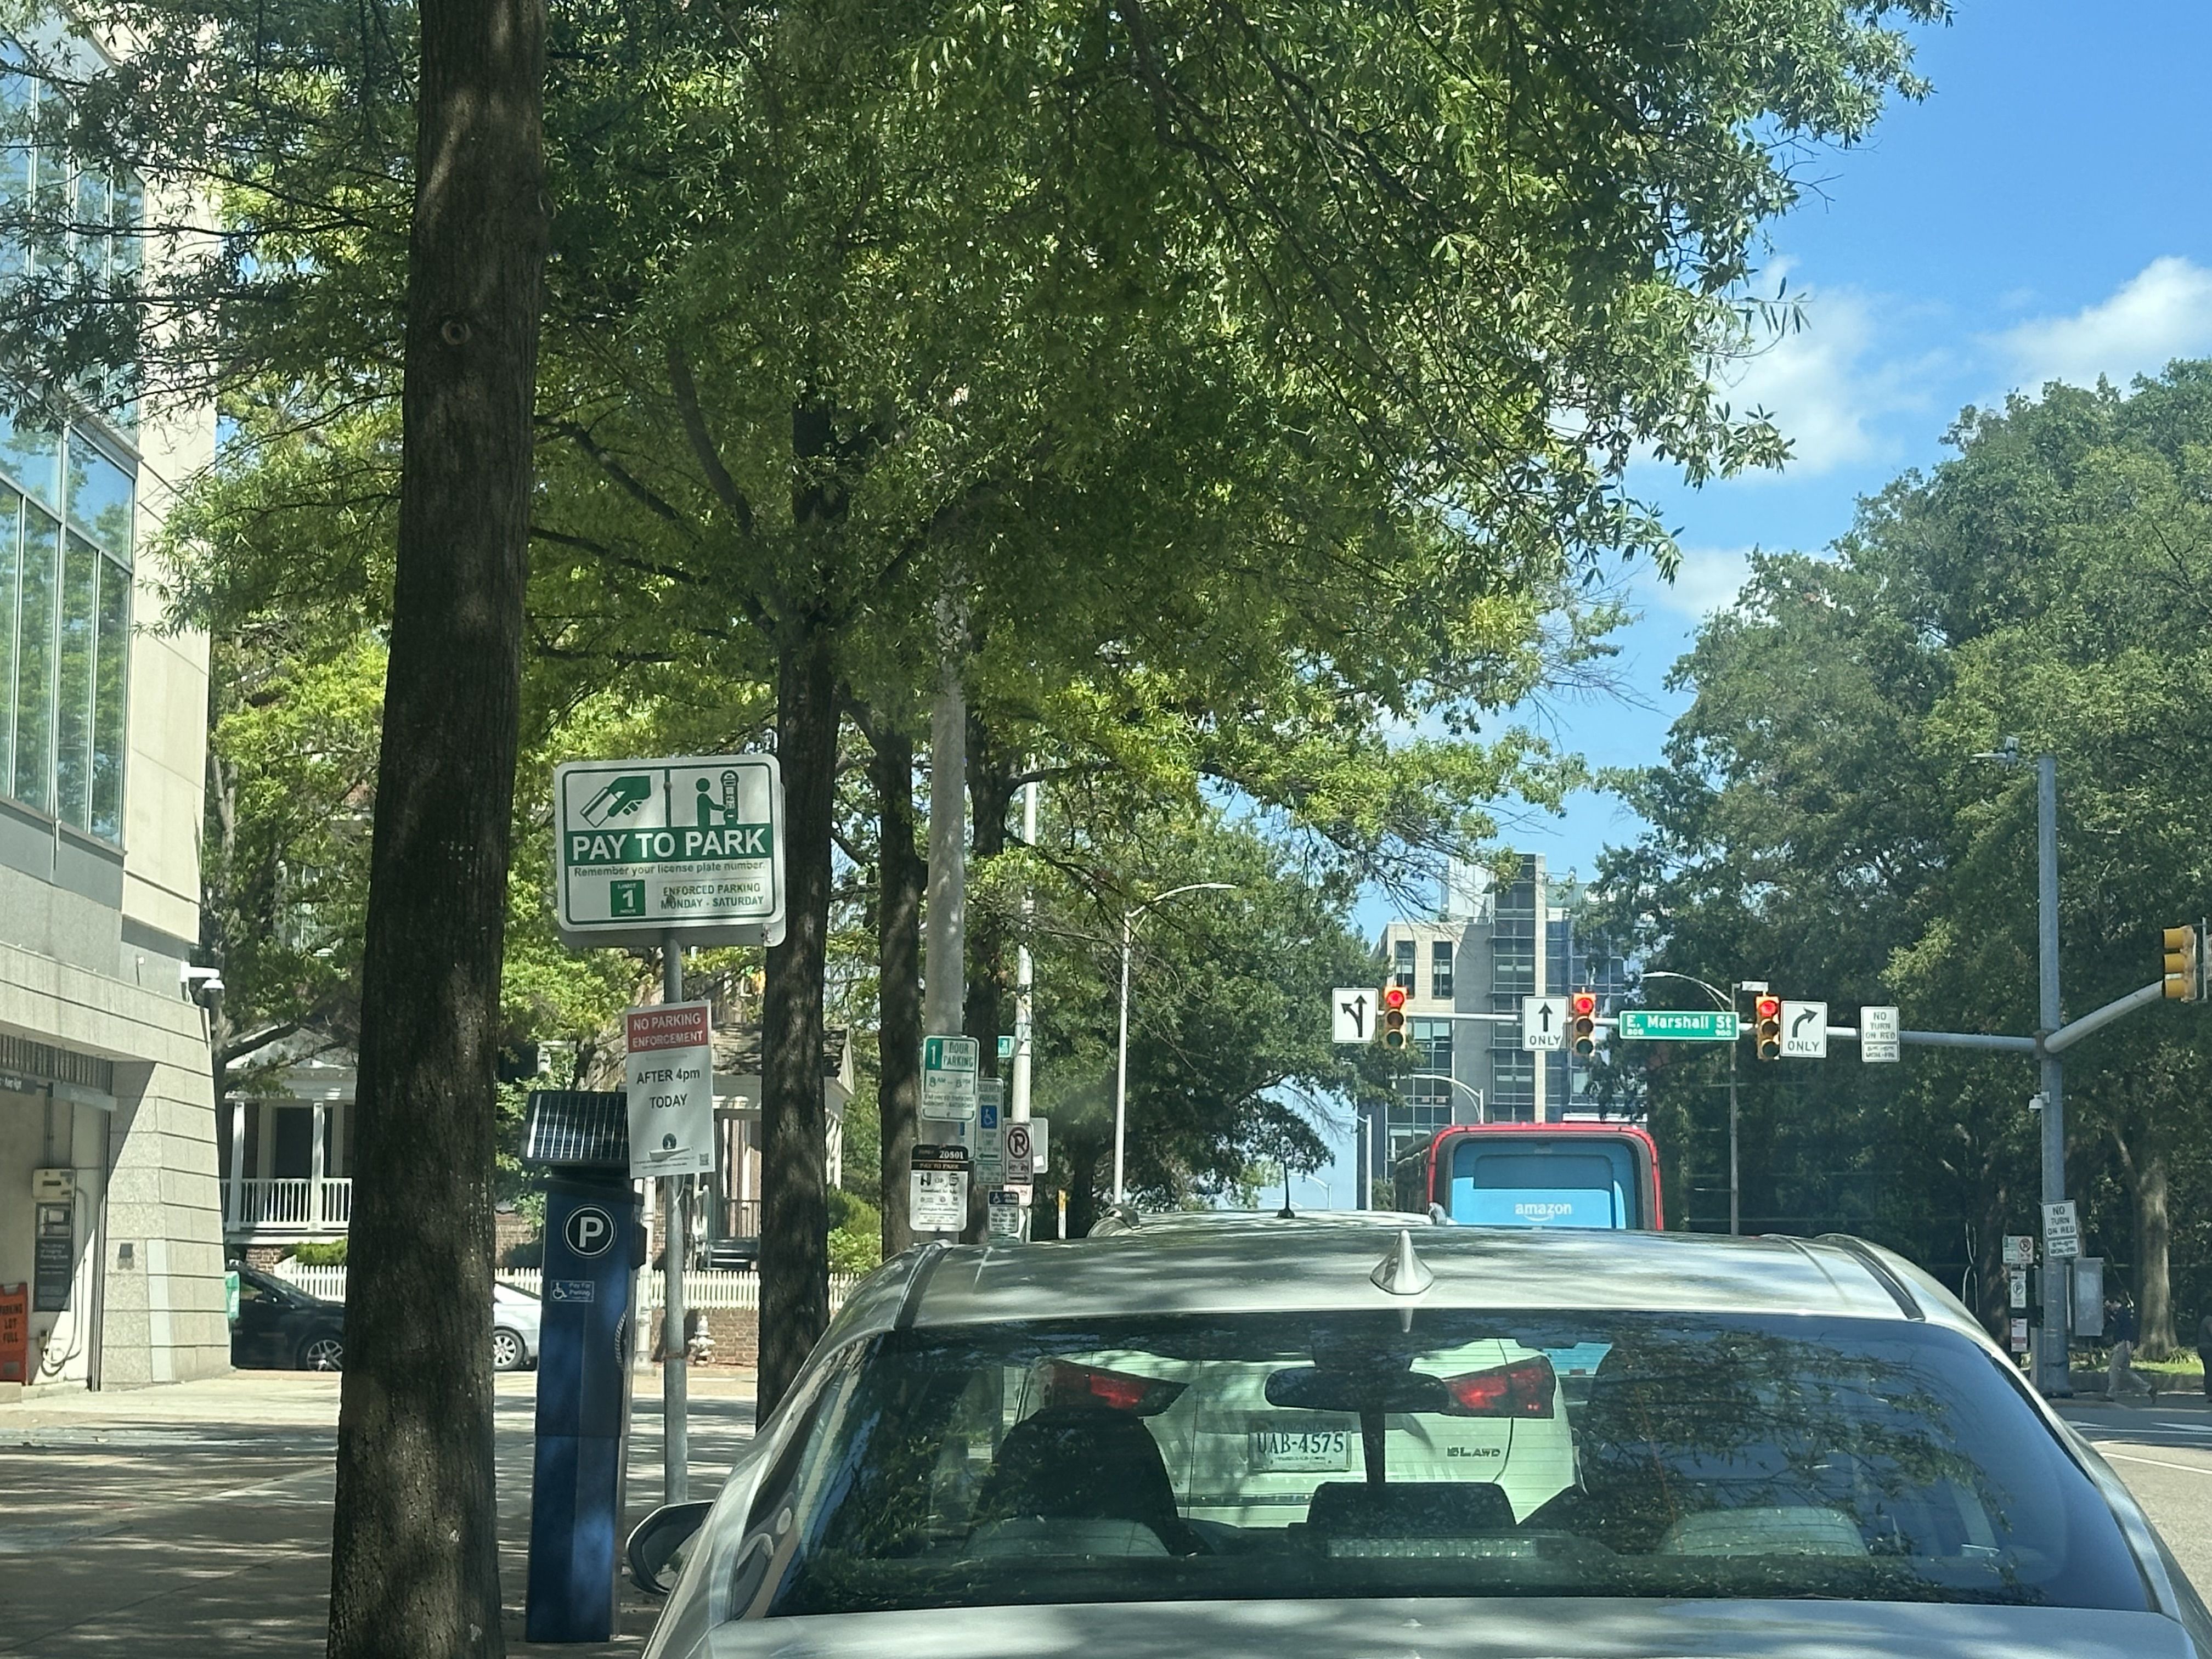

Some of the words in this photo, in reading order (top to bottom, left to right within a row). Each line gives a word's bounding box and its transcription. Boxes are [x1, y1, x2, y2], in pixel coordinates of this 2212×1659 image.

[573, 833, 628, 861] PAY
[635, 832, 675, 858] TO
[686, 828, 766, 856] PARK
[574, 866, 629, 877] Remember
[631, 866, 654, 876] your
[658, 864, 693, 874] license
[697, 862, 721, 873] plate
[663, 885, 715, 896] ENFORCED
[717, 883, 761, 894] PARKING
[622, 889, 634, 908] 1
[661, 898, 703, 910] MONDAY
[713, 895, 764, 907] SATURDAY
[633, 1018, 649, 1031] NO
[651, 1013, 701, 1029] PARKING
[1626, 1014, 1640, 1028] E.
[1647, 1015, 1709, 1029] Marshall
[1716, 1015, 1732, 1029] St
[1874, 1011, 1887, 1020] NO
[632, 1030, 703, 1048] ENFORCEMENT
[1530, 1034, 1561, 1046] ONLY
[1787, 1040, 1820, 1053] ONLY
[930, 1045, 936, 1065] 1
[943, 1056, 974, 1068] PARKING
[636, 1069, 673, 1085] AFTER
[675, 1068, 701, 1083] 4pm
[650, 1093, 687, 1109] TODAY
[1515, 1203, 1572, 1215] amazon
[2053, 1206, 2066, 1216] NO
[1257, 1432, 1344, 1454] UAB-4575
